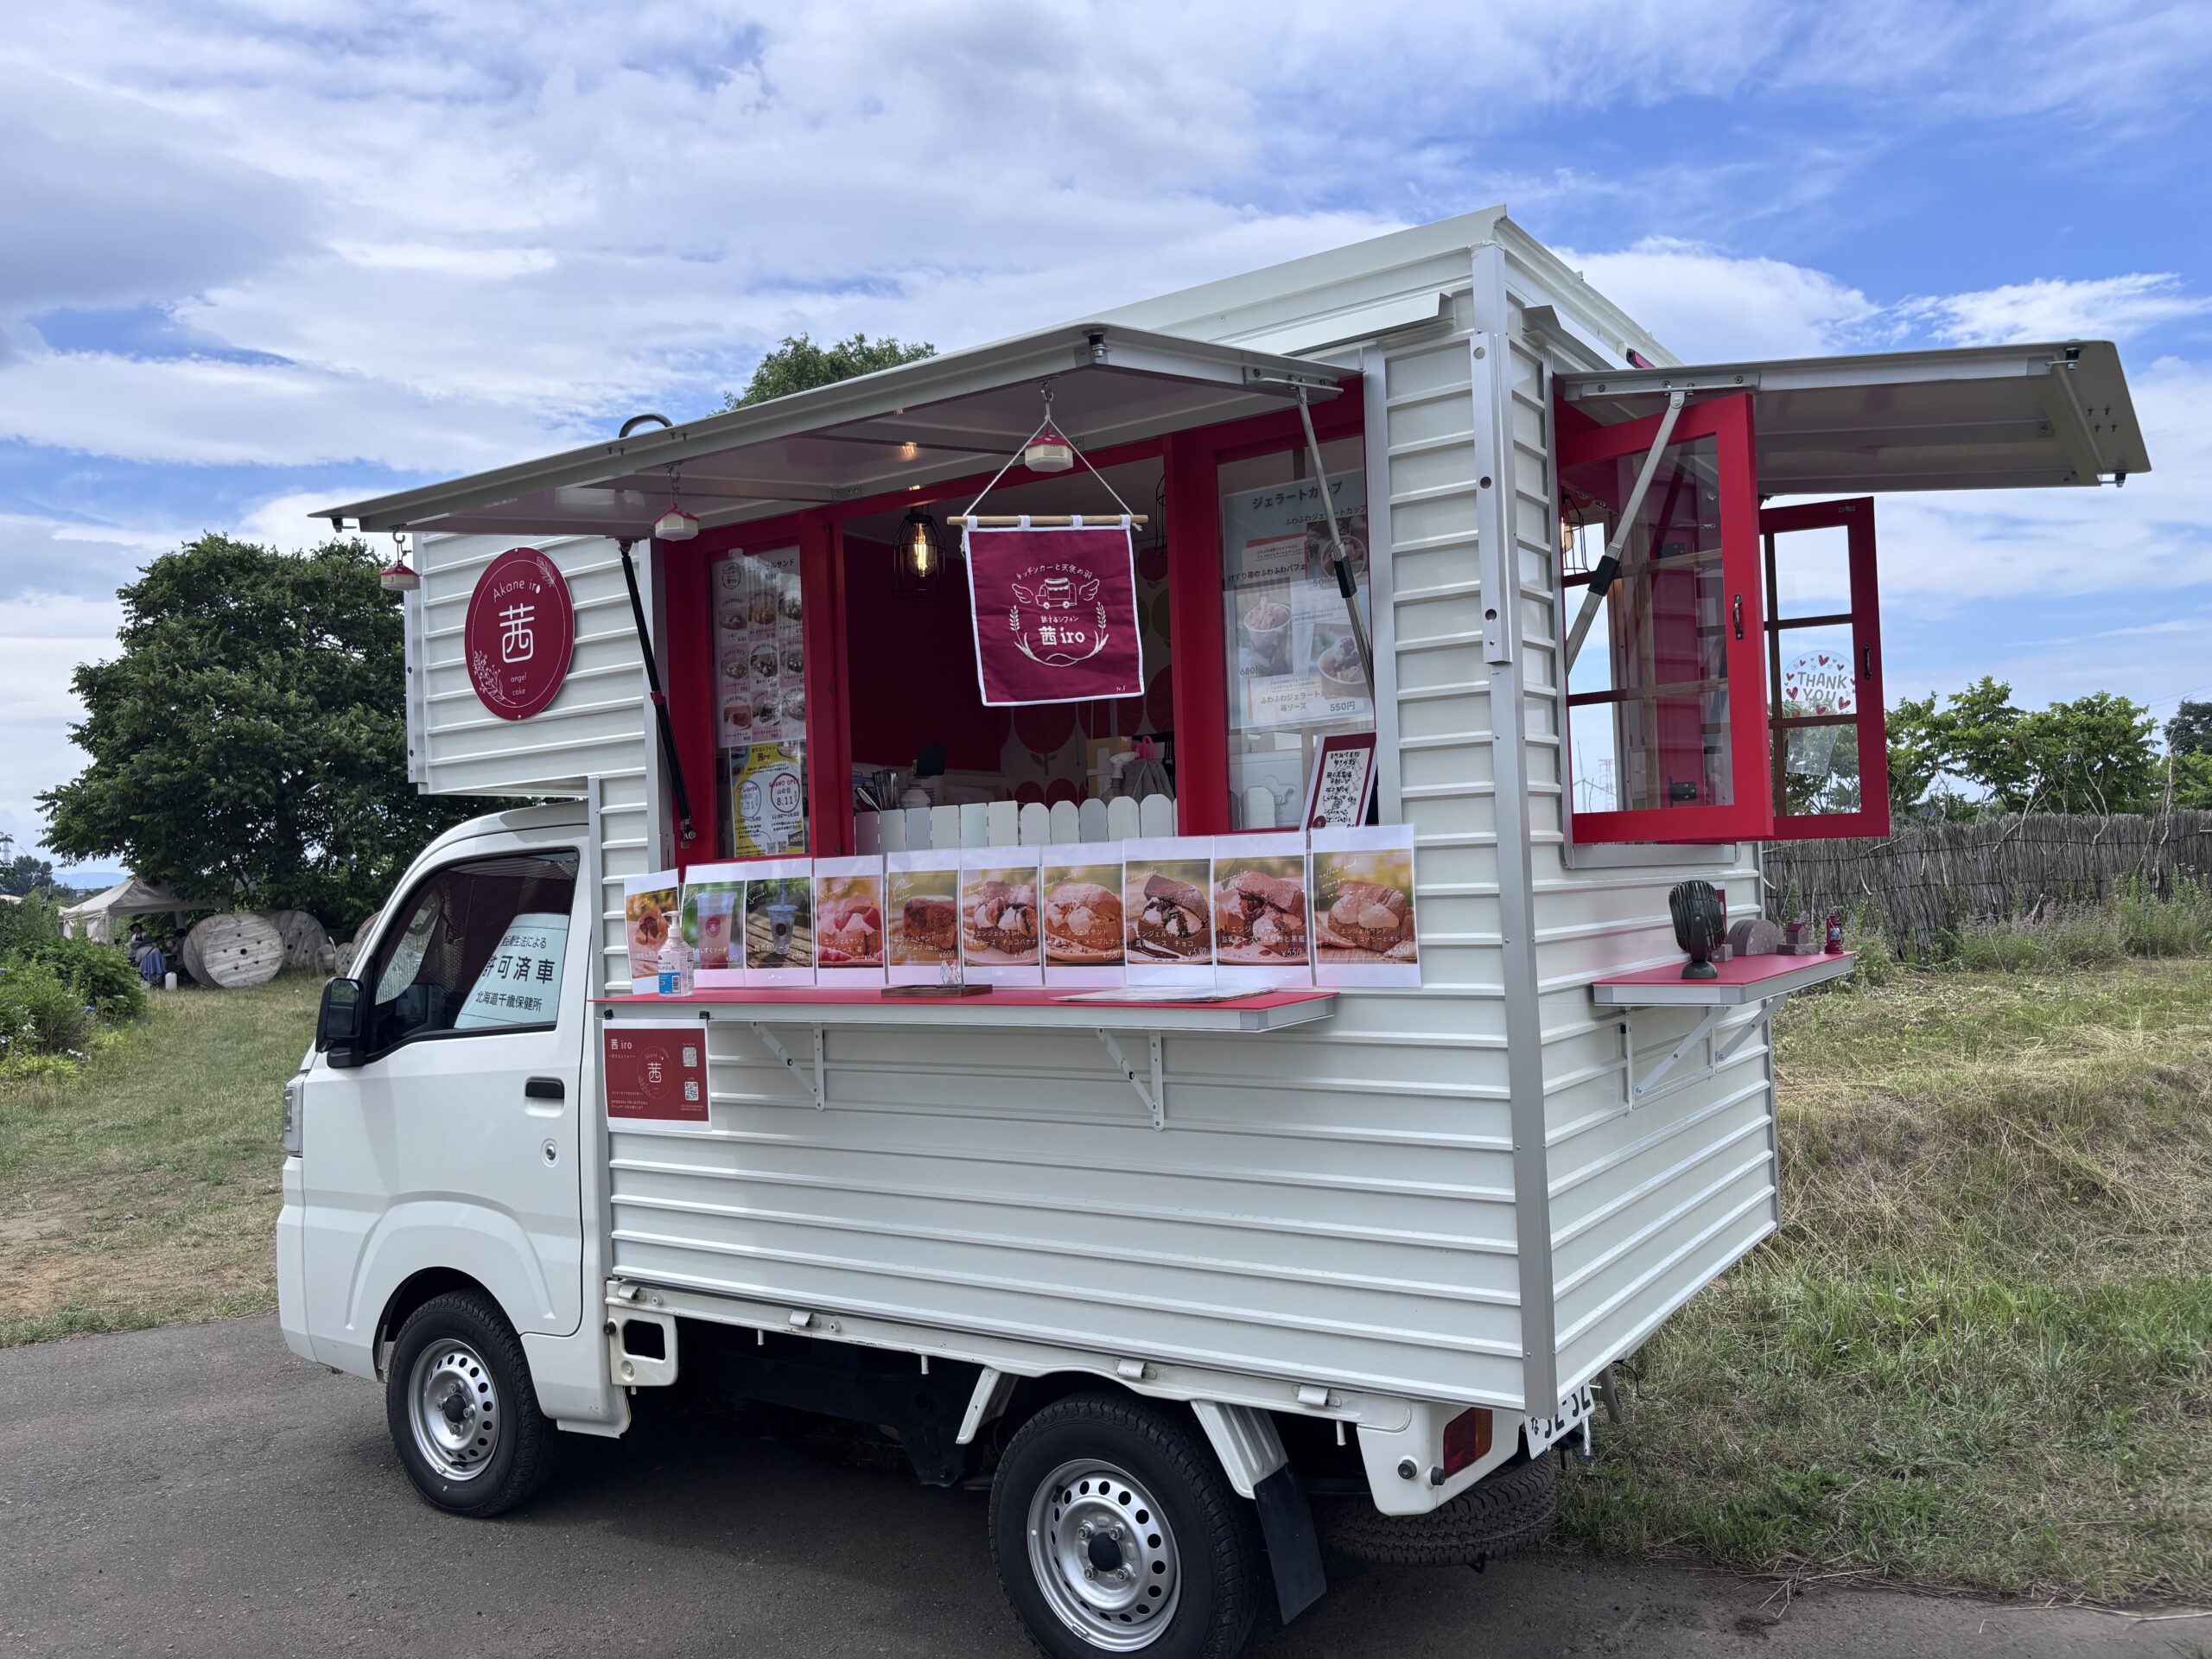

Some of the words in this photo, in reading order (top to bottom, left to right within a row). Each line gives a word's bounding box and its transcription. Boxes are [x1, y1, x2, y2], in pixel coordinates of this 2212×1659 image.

[1252, 481, 1343, 510] ジェラートカプ
[1285, 505, 1366, 525] ふわふわジェートカップ
[493, 579, 525, 603] Akane
[529, 579, 541, 594] iro
[499, 603, 535, 664] 茜
[511, 671, 527, 683] angel
[1797, 671, 1848, 690] THANK
[512, 687, 525, 696] cake
[1261, 689, 1341, 704] ふわふわジェラートカプ
[1802, 689, 1836, 702] YOU
[1330, 701, 1356, 712] 550円
[777, 796, 793, 806] 8.11
[475, 991, 543, 1013] 北海道千歳保健所
[611, 1039, 619, 1050] 茜
[621, 1040, 632, 1050] iro
[648, 1062, 661, 1083] 茜
